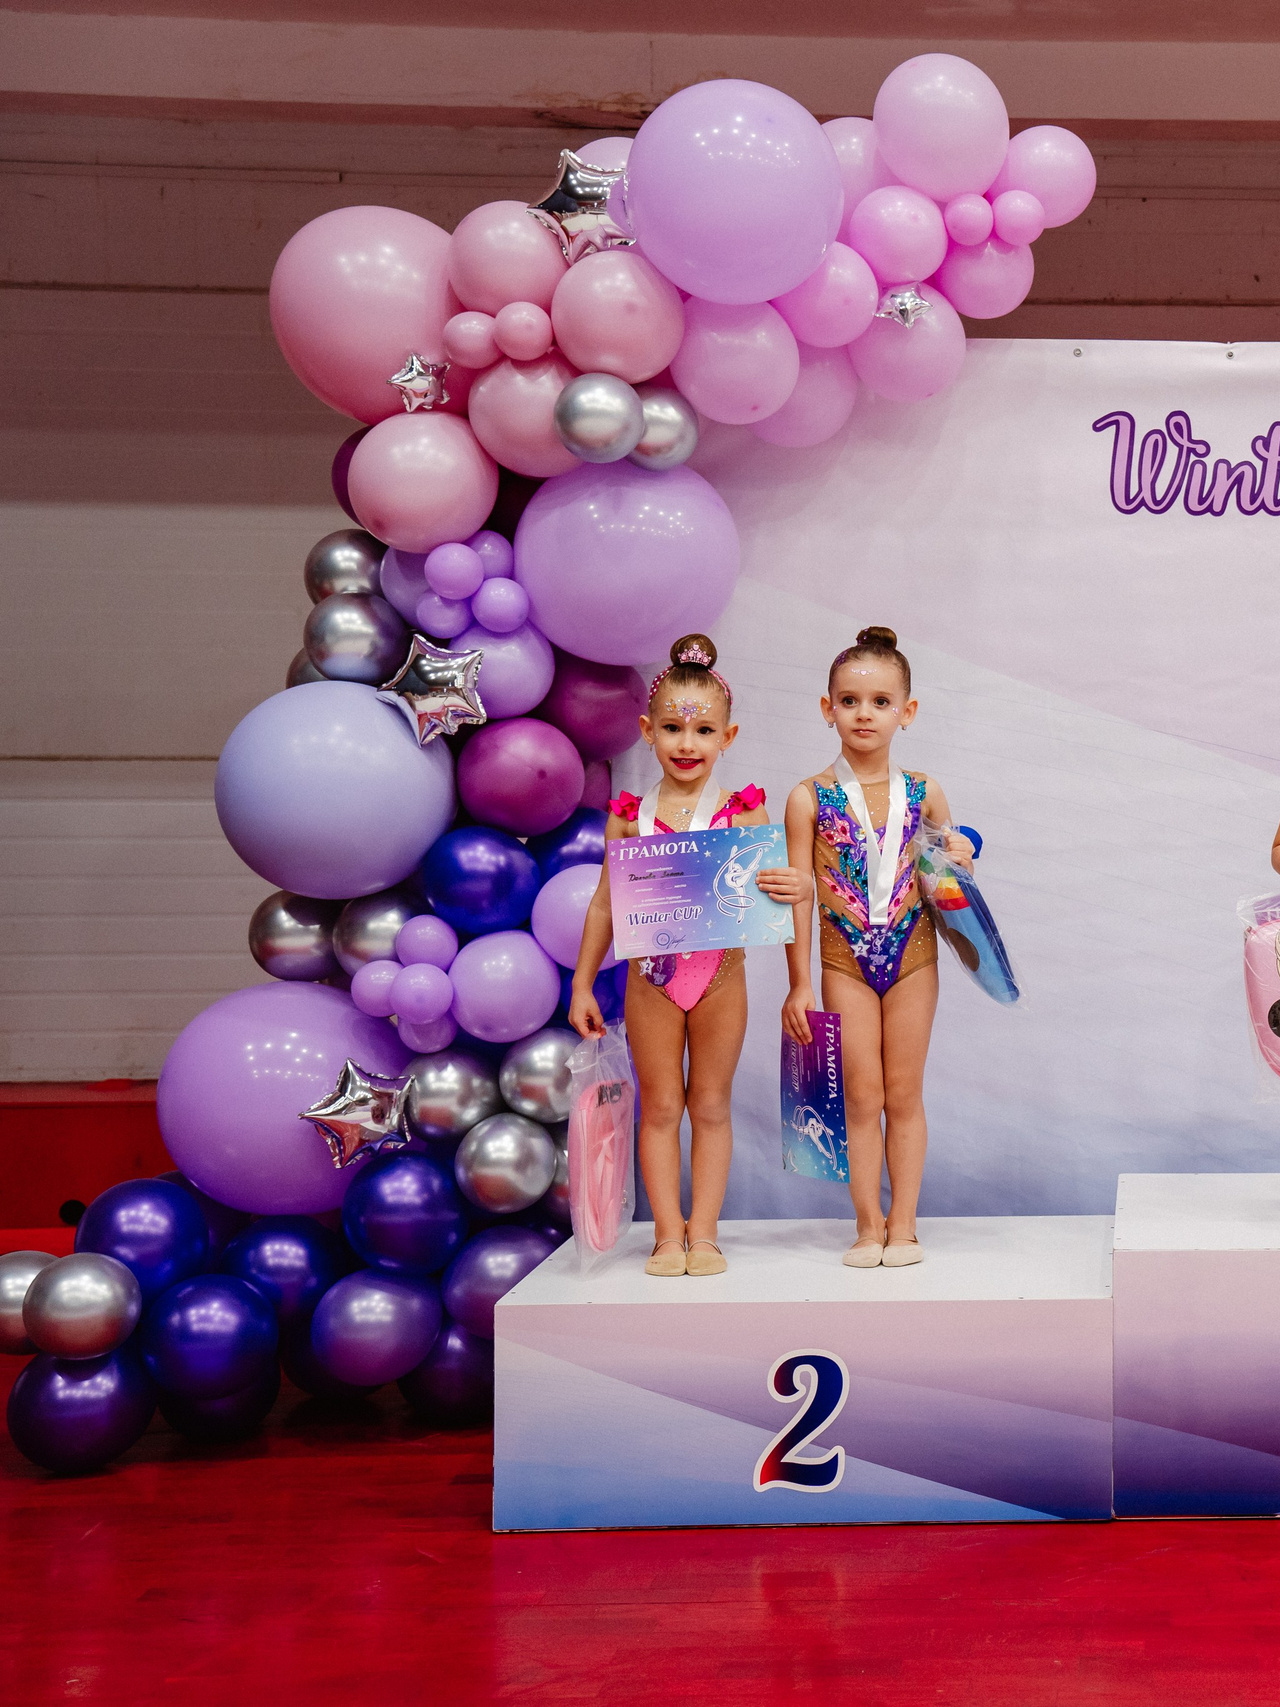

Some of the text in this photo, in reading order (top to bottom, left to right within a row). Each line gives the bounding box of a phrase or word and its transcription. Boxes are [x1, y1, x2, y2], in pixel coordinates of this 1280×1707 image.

[618, 840, 700, 861] ГРАМОТА
[625, 904, 704, 927] Winter CUP
[857, 945, 864, 953] 2
[645, 962, 650, 971] 2
[825, 1022, 839, 1100] ГРАМОТА
[752, 1347, 850, 1494] 2
